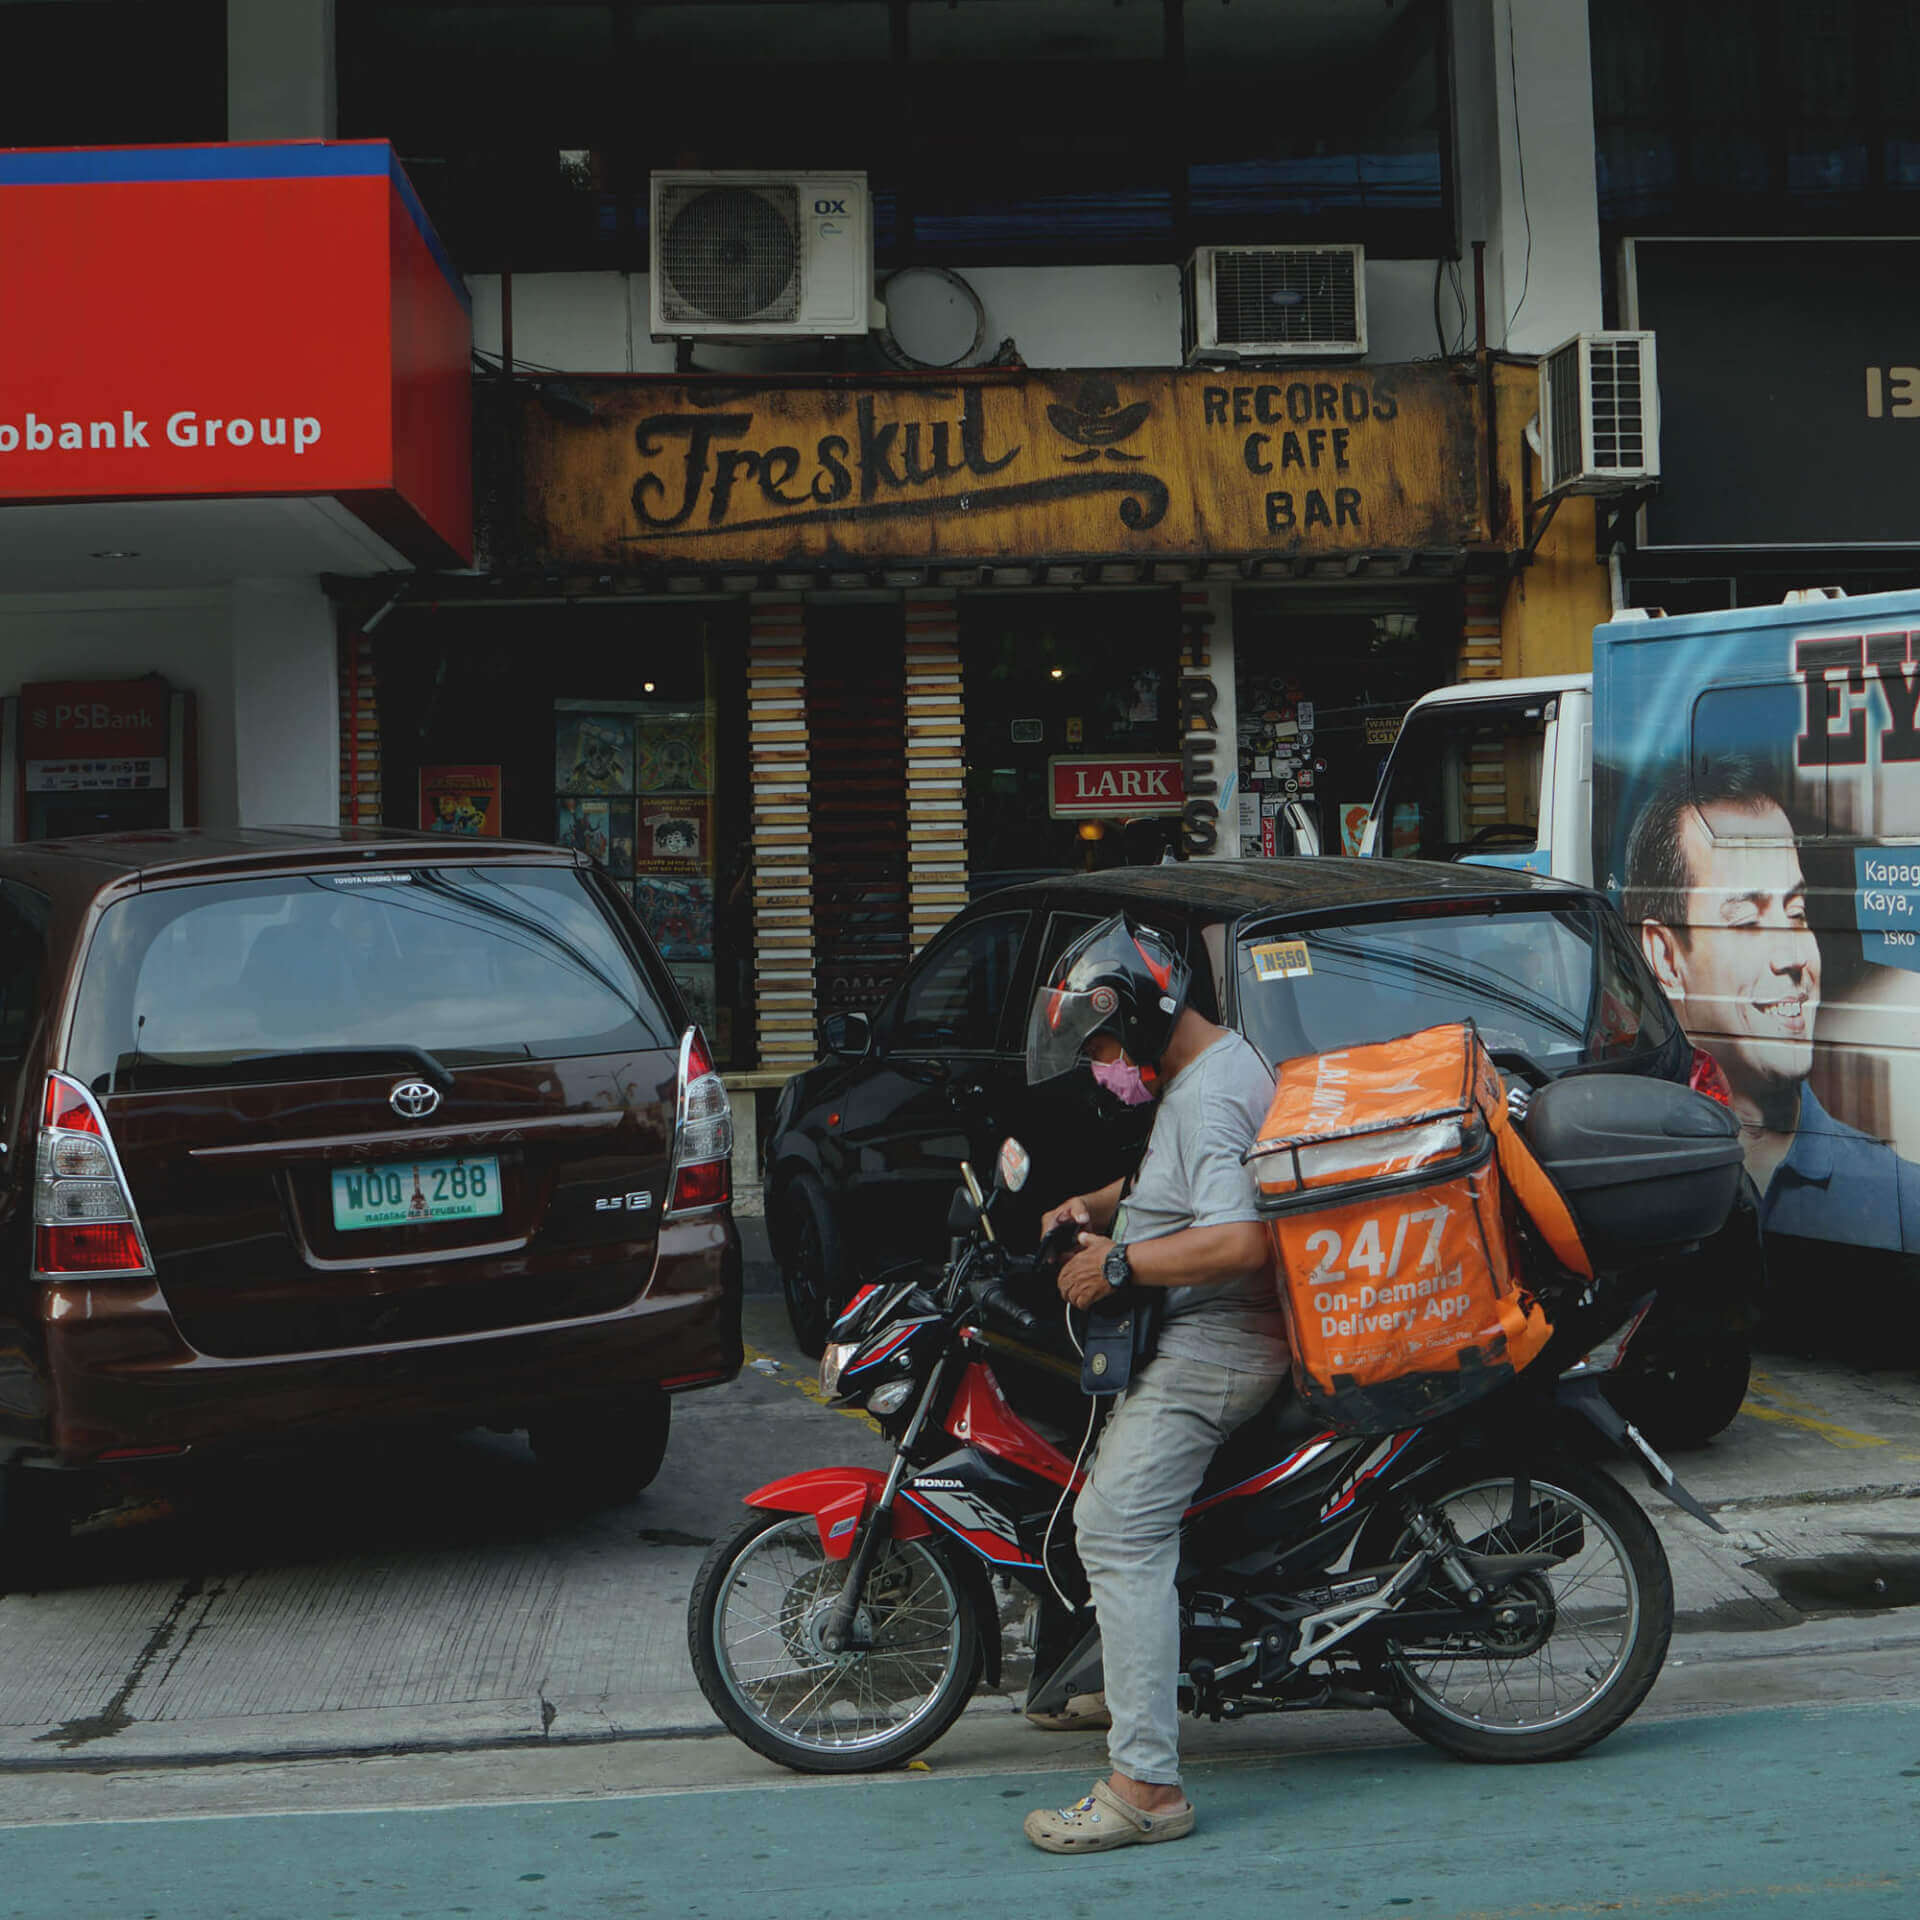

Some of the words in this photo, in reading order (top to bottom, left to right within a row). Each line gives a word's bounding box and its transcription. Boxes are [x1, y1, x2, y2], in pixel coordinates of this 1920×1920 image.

[814, 200, 846, 215] OX
[1203, 382, 1398, 427] RECORDS
[0, 410, 150, 452] obank
[166, 410, 322, 455] Group
[1244, 427, 1351, 475] CAFE
[631, 386, 1021, 528] Treskul
[1265, 486, 1362, 535] BAR
[55, 703, 153, 729] PSBank
[1181, 611, 1219, 855] TRES
[1074, 769, 1171, 798] LARK
[1864, 860, 1920, 887] Kapag
[1863, 889, 1914, 916] Kaya,
[431, 1165, 487, 1201] 288
[1305, 1205, 1449, 1286] 24/7
[1313, 1262, 1463, 1313] On-Demand
[1321, 1308, 1417, 1338] Delivery
[1422, 1294, 1471, 1322] App
[913, 1478, 965, 1488] HONDA
